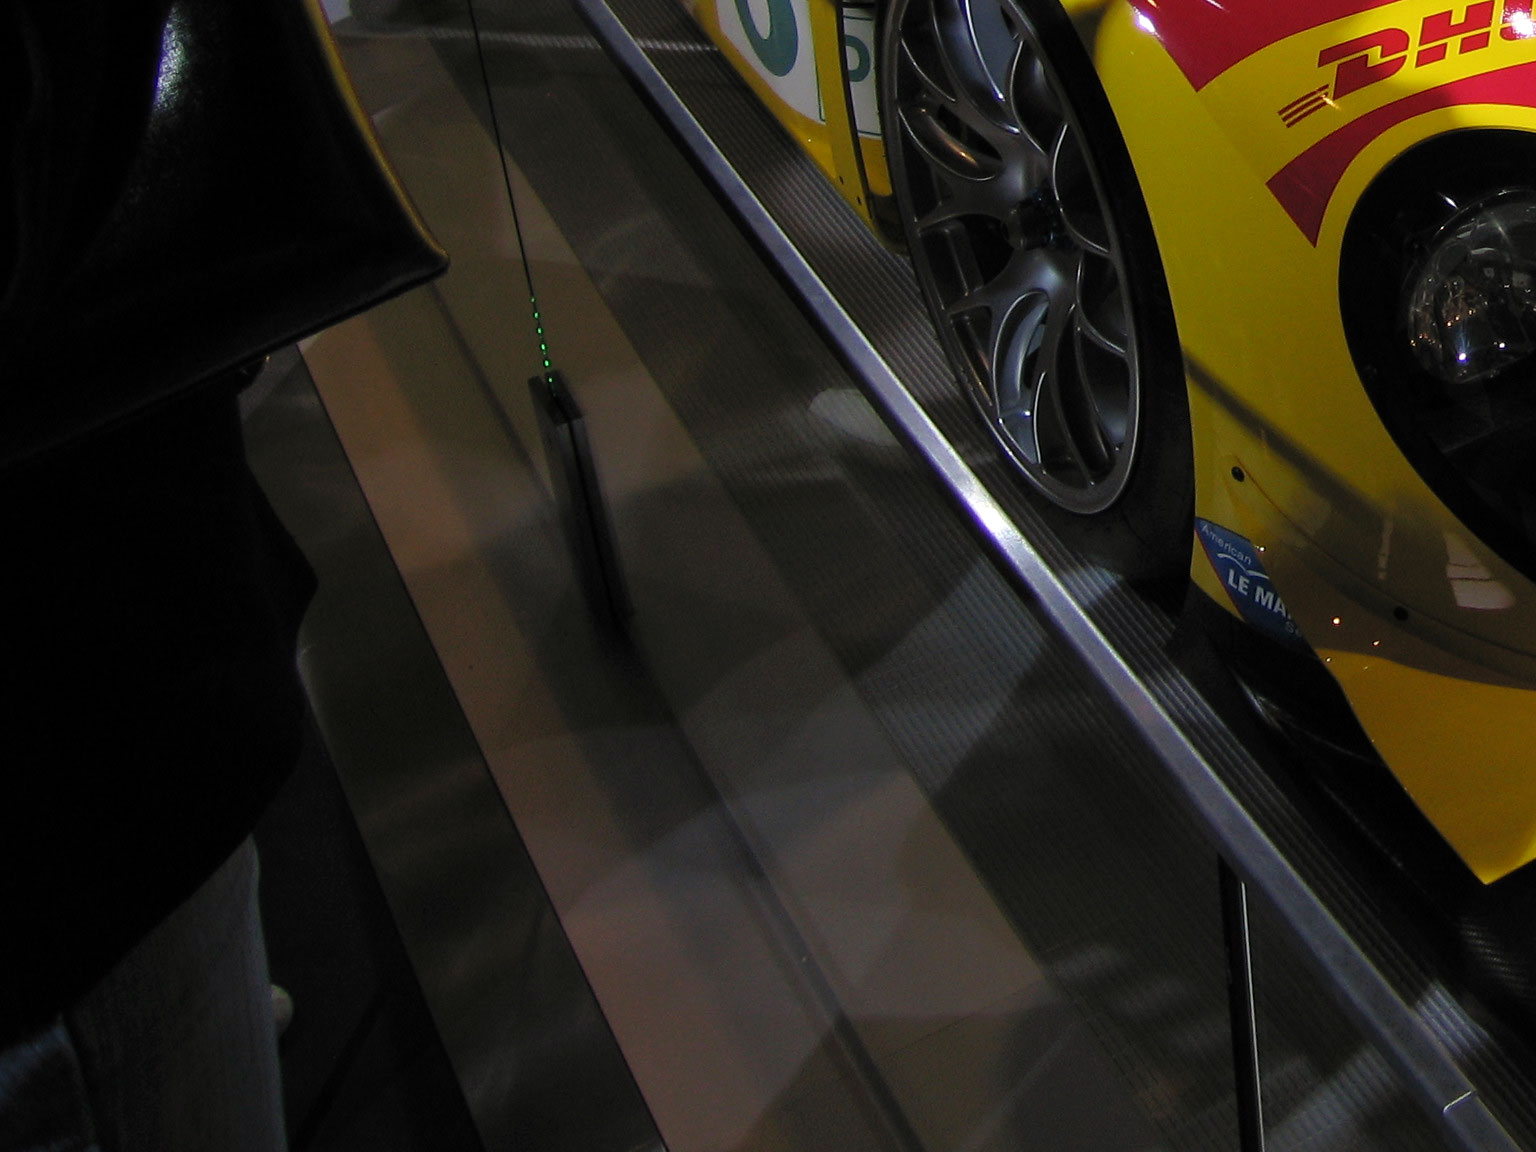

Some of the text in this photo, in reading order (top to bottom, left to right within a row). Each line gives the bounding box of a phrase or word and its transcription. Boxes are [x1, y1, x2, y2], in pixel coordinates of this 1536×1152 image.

[1201, 524, 1252, 566] American
[1228, 568, 1291, 620] LE MA
